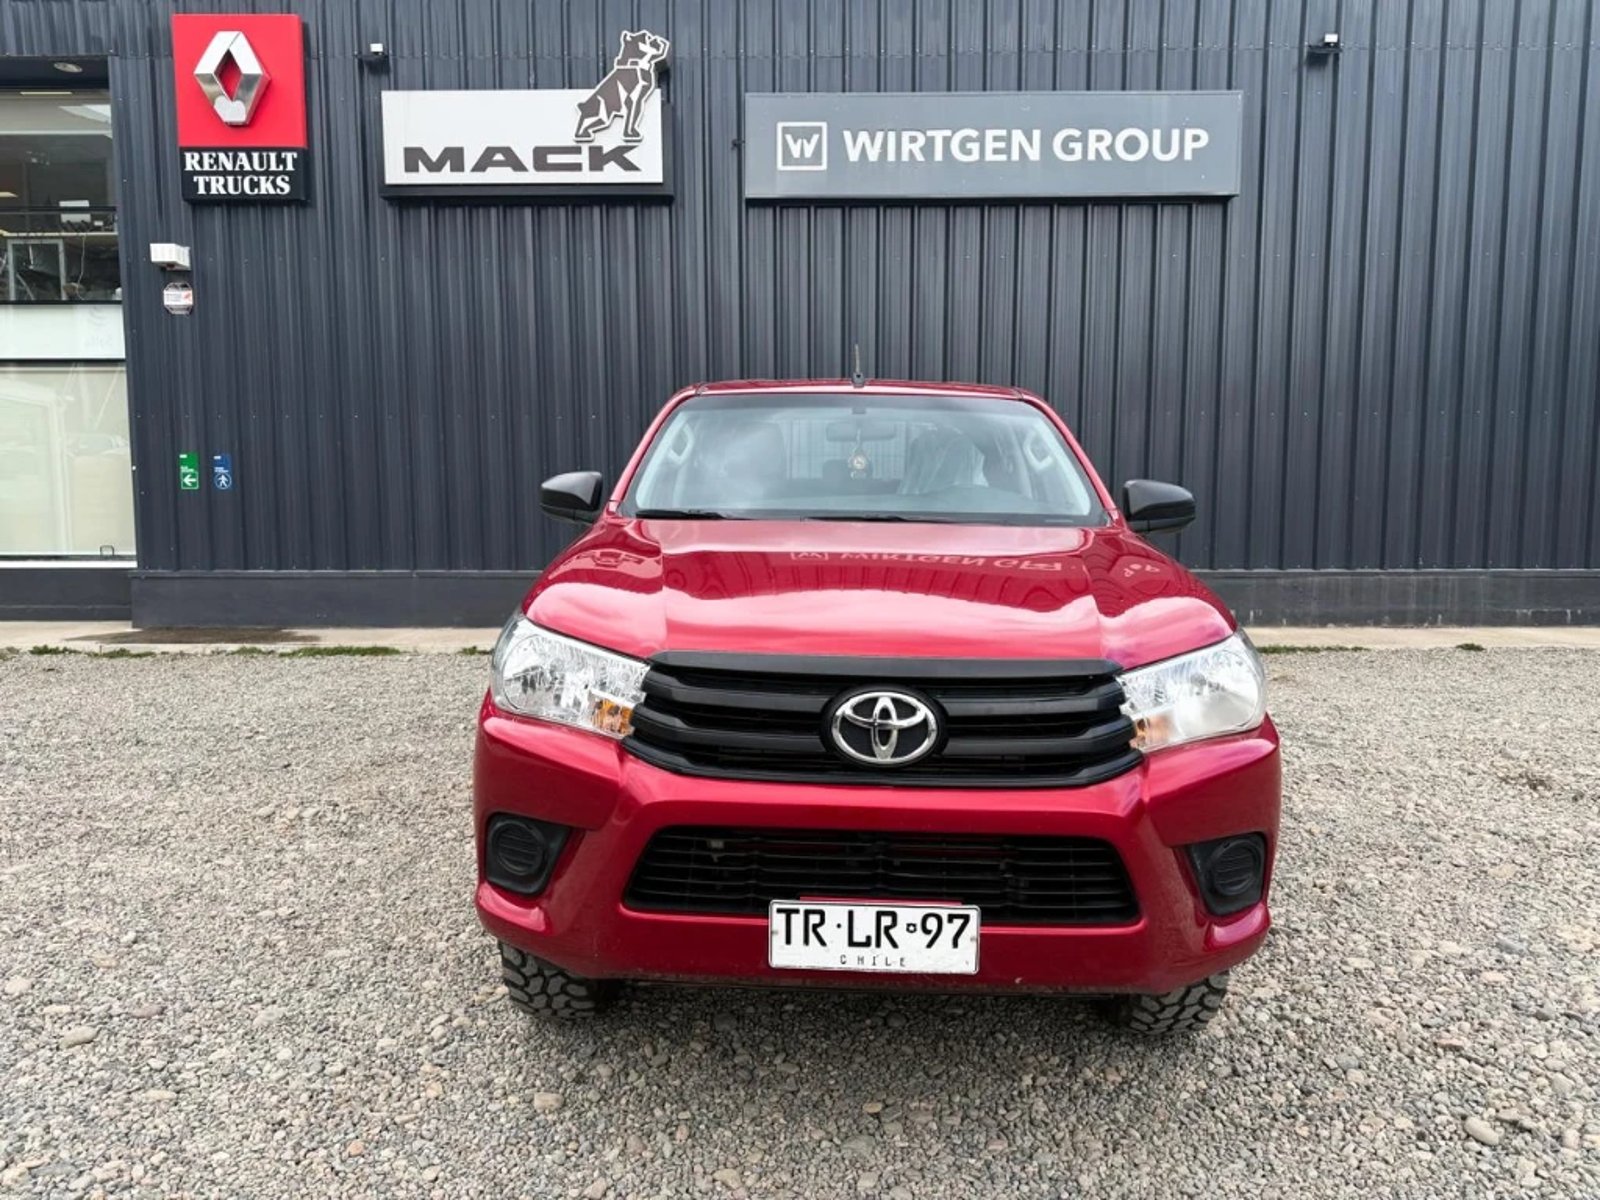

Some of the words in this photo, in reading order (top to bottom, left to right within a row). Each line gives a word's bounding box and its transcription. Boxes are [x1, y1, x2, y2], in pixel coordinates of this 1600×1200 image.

[843, 128, 1041, 162] WIRTGEN
[1052, 127, 1210, 162] GROUP
[184, 151, 298, 171] RENAULT
[403, 145, 642, 173] MACK
[193, 174, 291, 195] TRUCKS
[840, 954, 906, 967] CHILE
